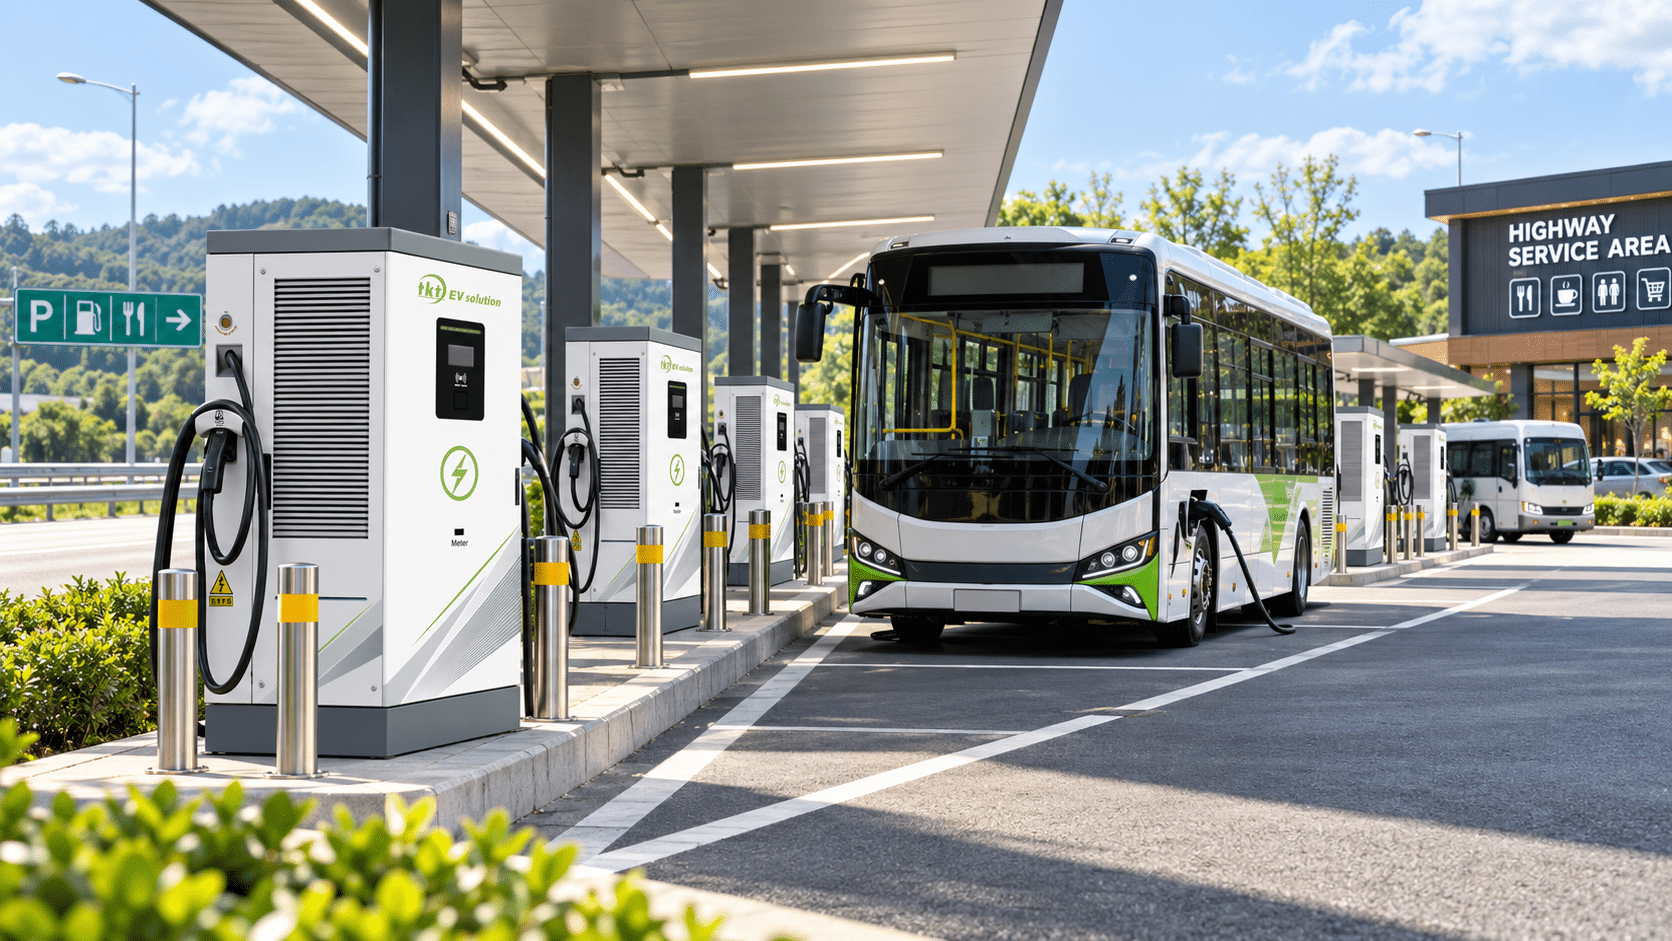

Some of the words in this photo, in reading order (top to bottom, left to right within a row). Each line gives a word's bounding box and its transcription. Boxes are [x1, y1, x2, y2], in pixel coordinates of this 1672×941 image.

[1509, 214, 1615, 243] HIGHWAY
[1508, 240, 1599, 267] SERVICE
[1607, 234, 1671, 258] AREA
[418, 281, 445, 300] tkt
[449, 289, 464, 301] EV
[465, 294, 501, 308] solution
[30, 299, 53, 333] P
[451, 539, 468, 547] Meter
